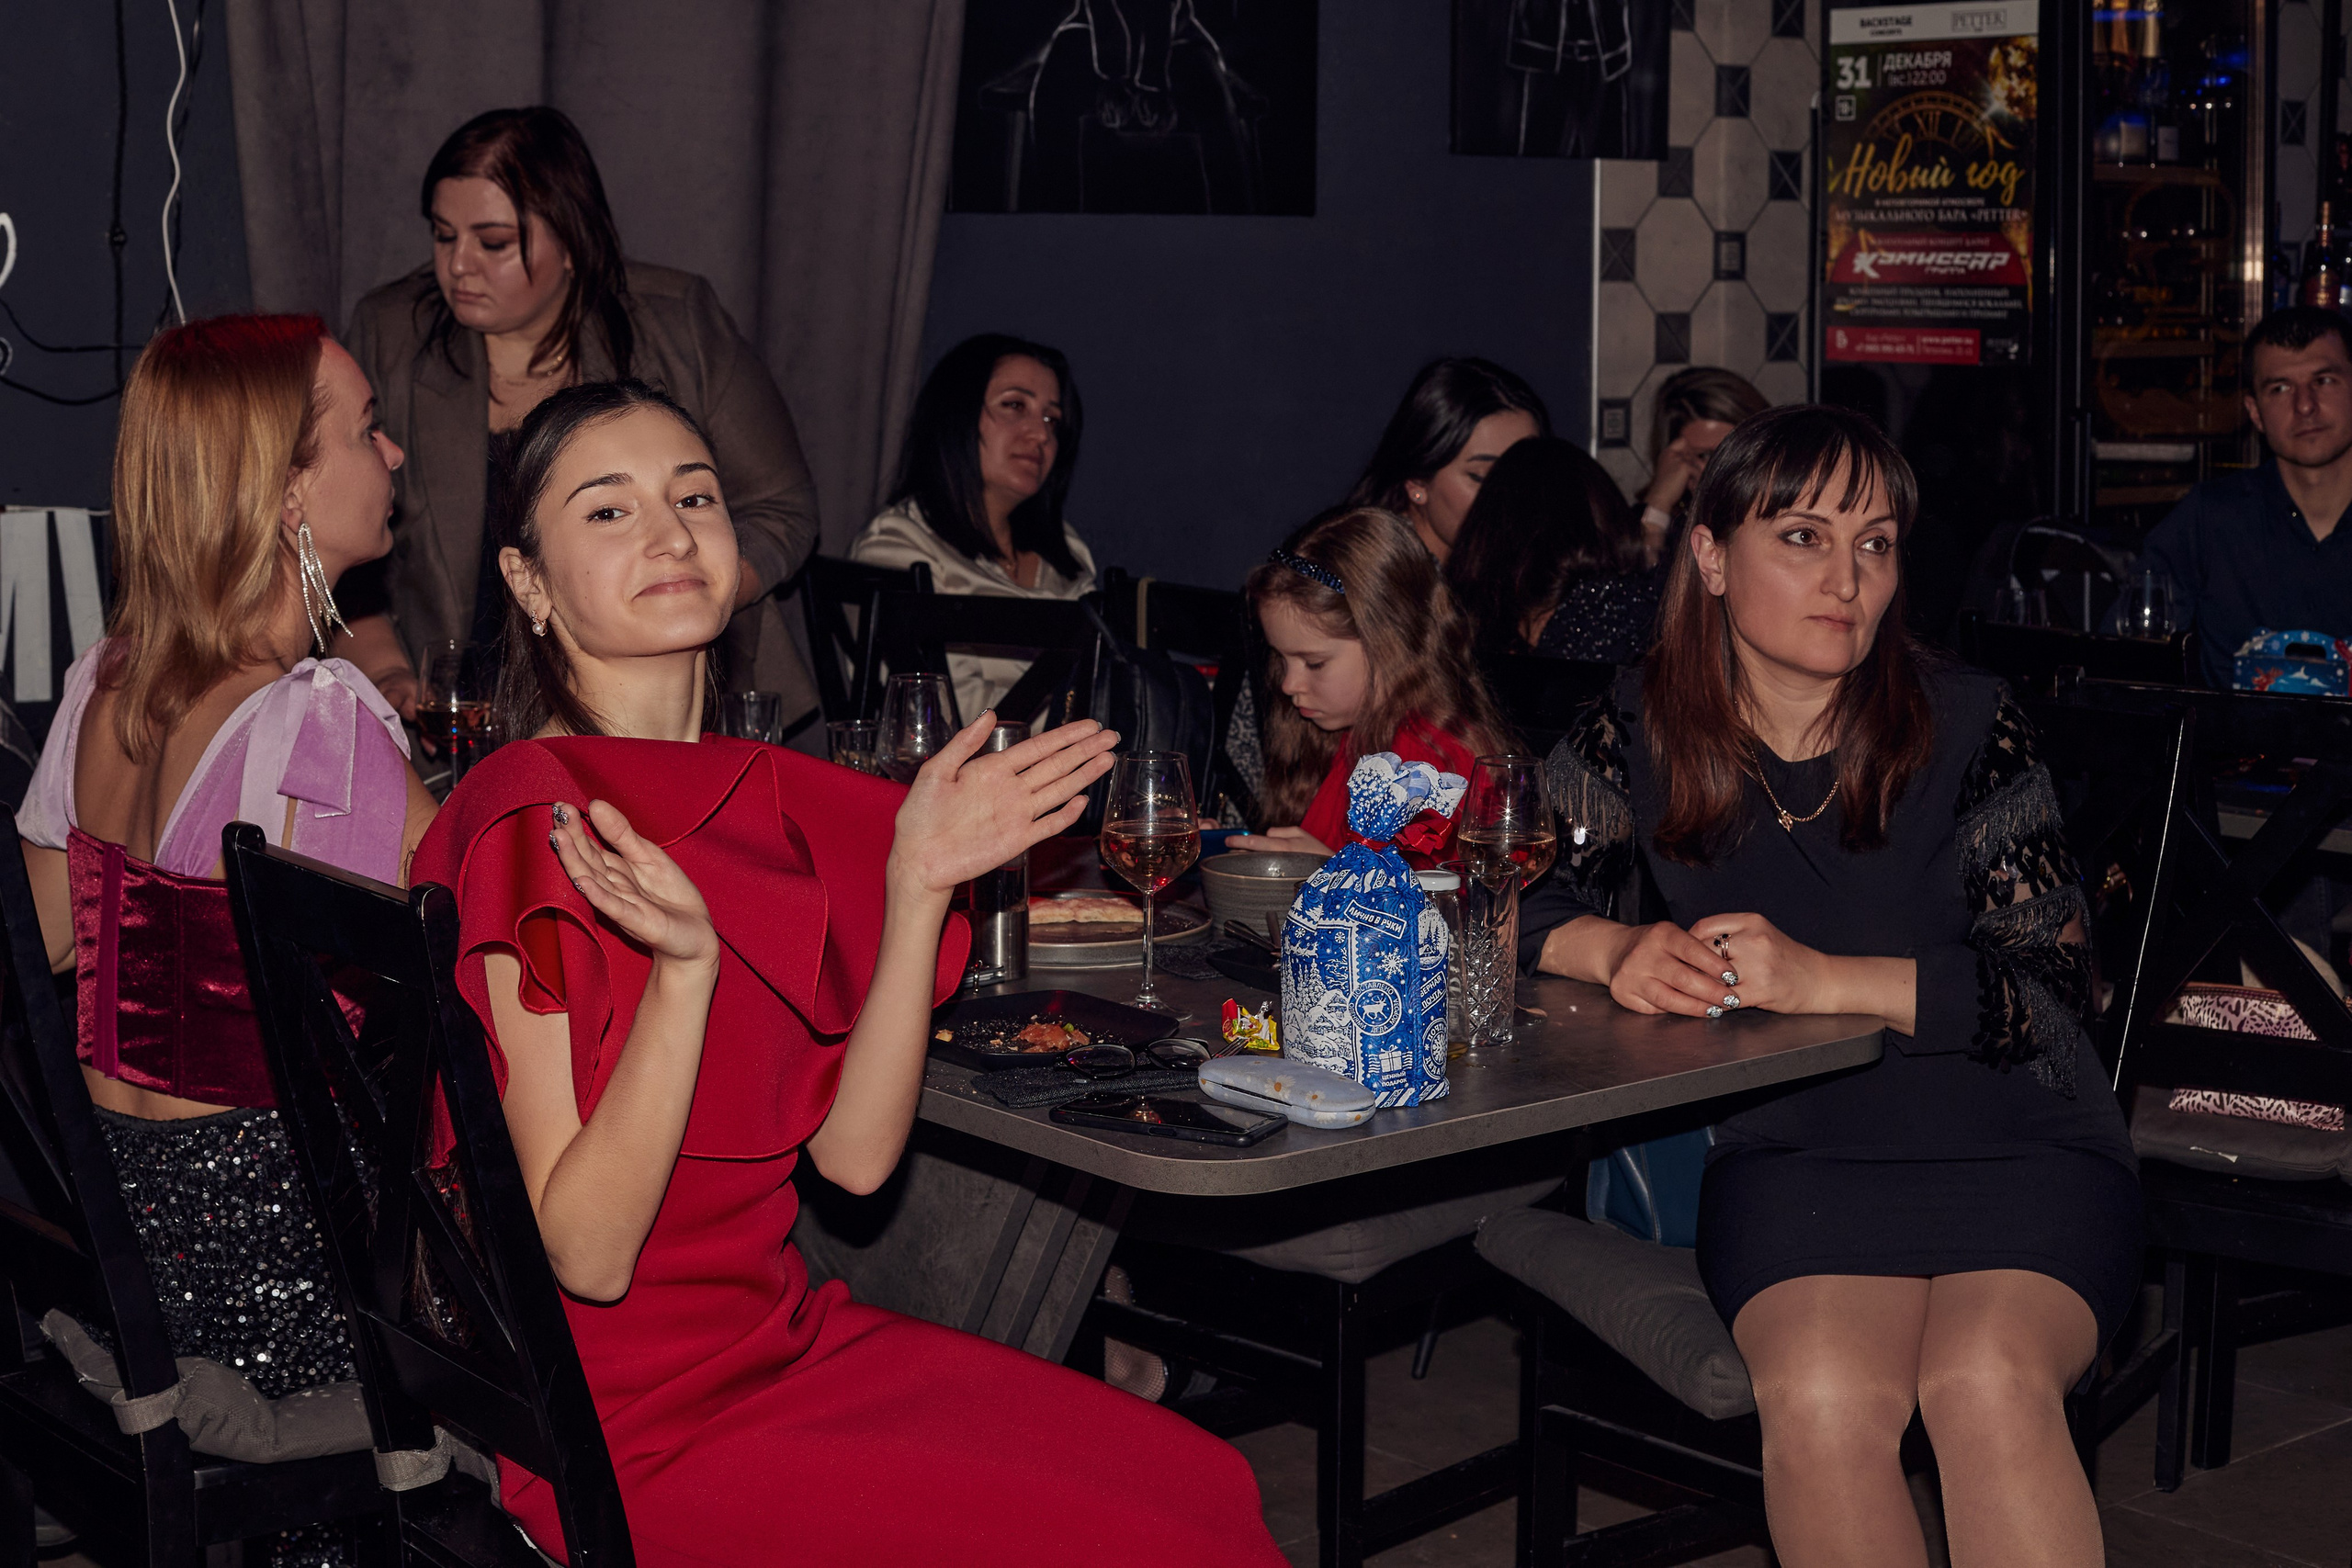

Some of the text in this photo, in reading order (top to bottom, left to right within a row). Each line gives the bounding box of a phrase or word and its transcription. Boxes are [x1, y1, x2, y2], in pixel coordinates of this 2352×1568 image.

[1860, 16, 1912, 28] BACKSTAGE
[1883, 51, 1952, 72] ДЕКАБРЯ
[1837, 56, 1871, 90] 31
[1843, 132, 2026, 207] Новый год
[1349, 907, 1374, 923] ЛИЧНО
[1374, 916, 1382, 924] В
[1380, 919, 1402, 933] РУКИ
[1352, 983, 1395, 1000] ДОСТАВЛЕНО
[1421, 988, 1442, 1010] ПОЧТА
[1382, 1070, 1407, 1081] ЦЕННЫЙ
[1382, 1077, 1408, 1088] ПОДАРОК
